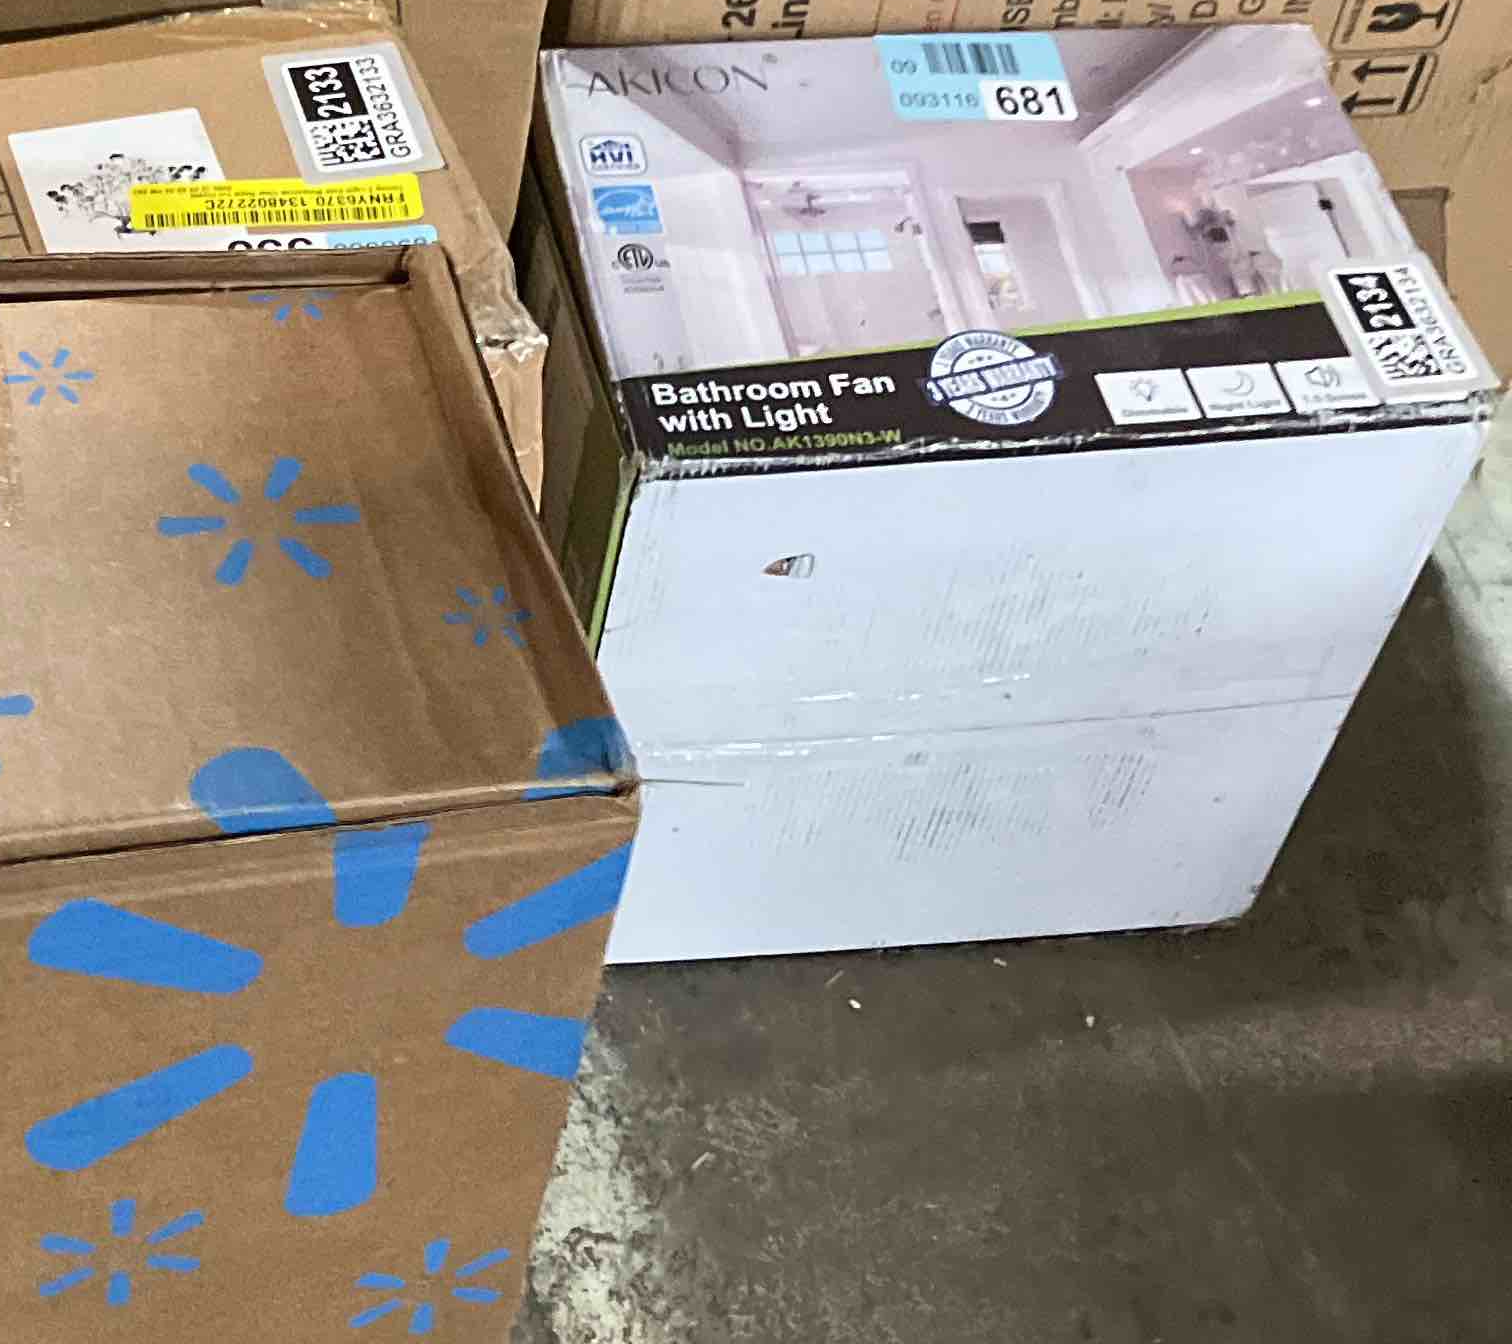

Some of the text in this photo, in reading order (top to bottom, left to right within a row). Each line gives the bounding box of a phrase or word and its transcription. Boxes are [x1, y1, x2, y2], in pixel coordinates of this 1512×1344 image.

[587, 64, 769, 98] AKICON
[891, 59, 918, 75] 09
[304, 67, 353, 118] 2133
[355, 57, 412, 158] GRA3632133
[899, 90, 979, 109] 093116
[995, 85, 1067, 117] 681
[1347, 274, 1403, 329] 2134
[651, 372, 896, 407] Bathroom Fan
[657, 401, 833, 433] with Light
[666, 438, 729, 457] Model
